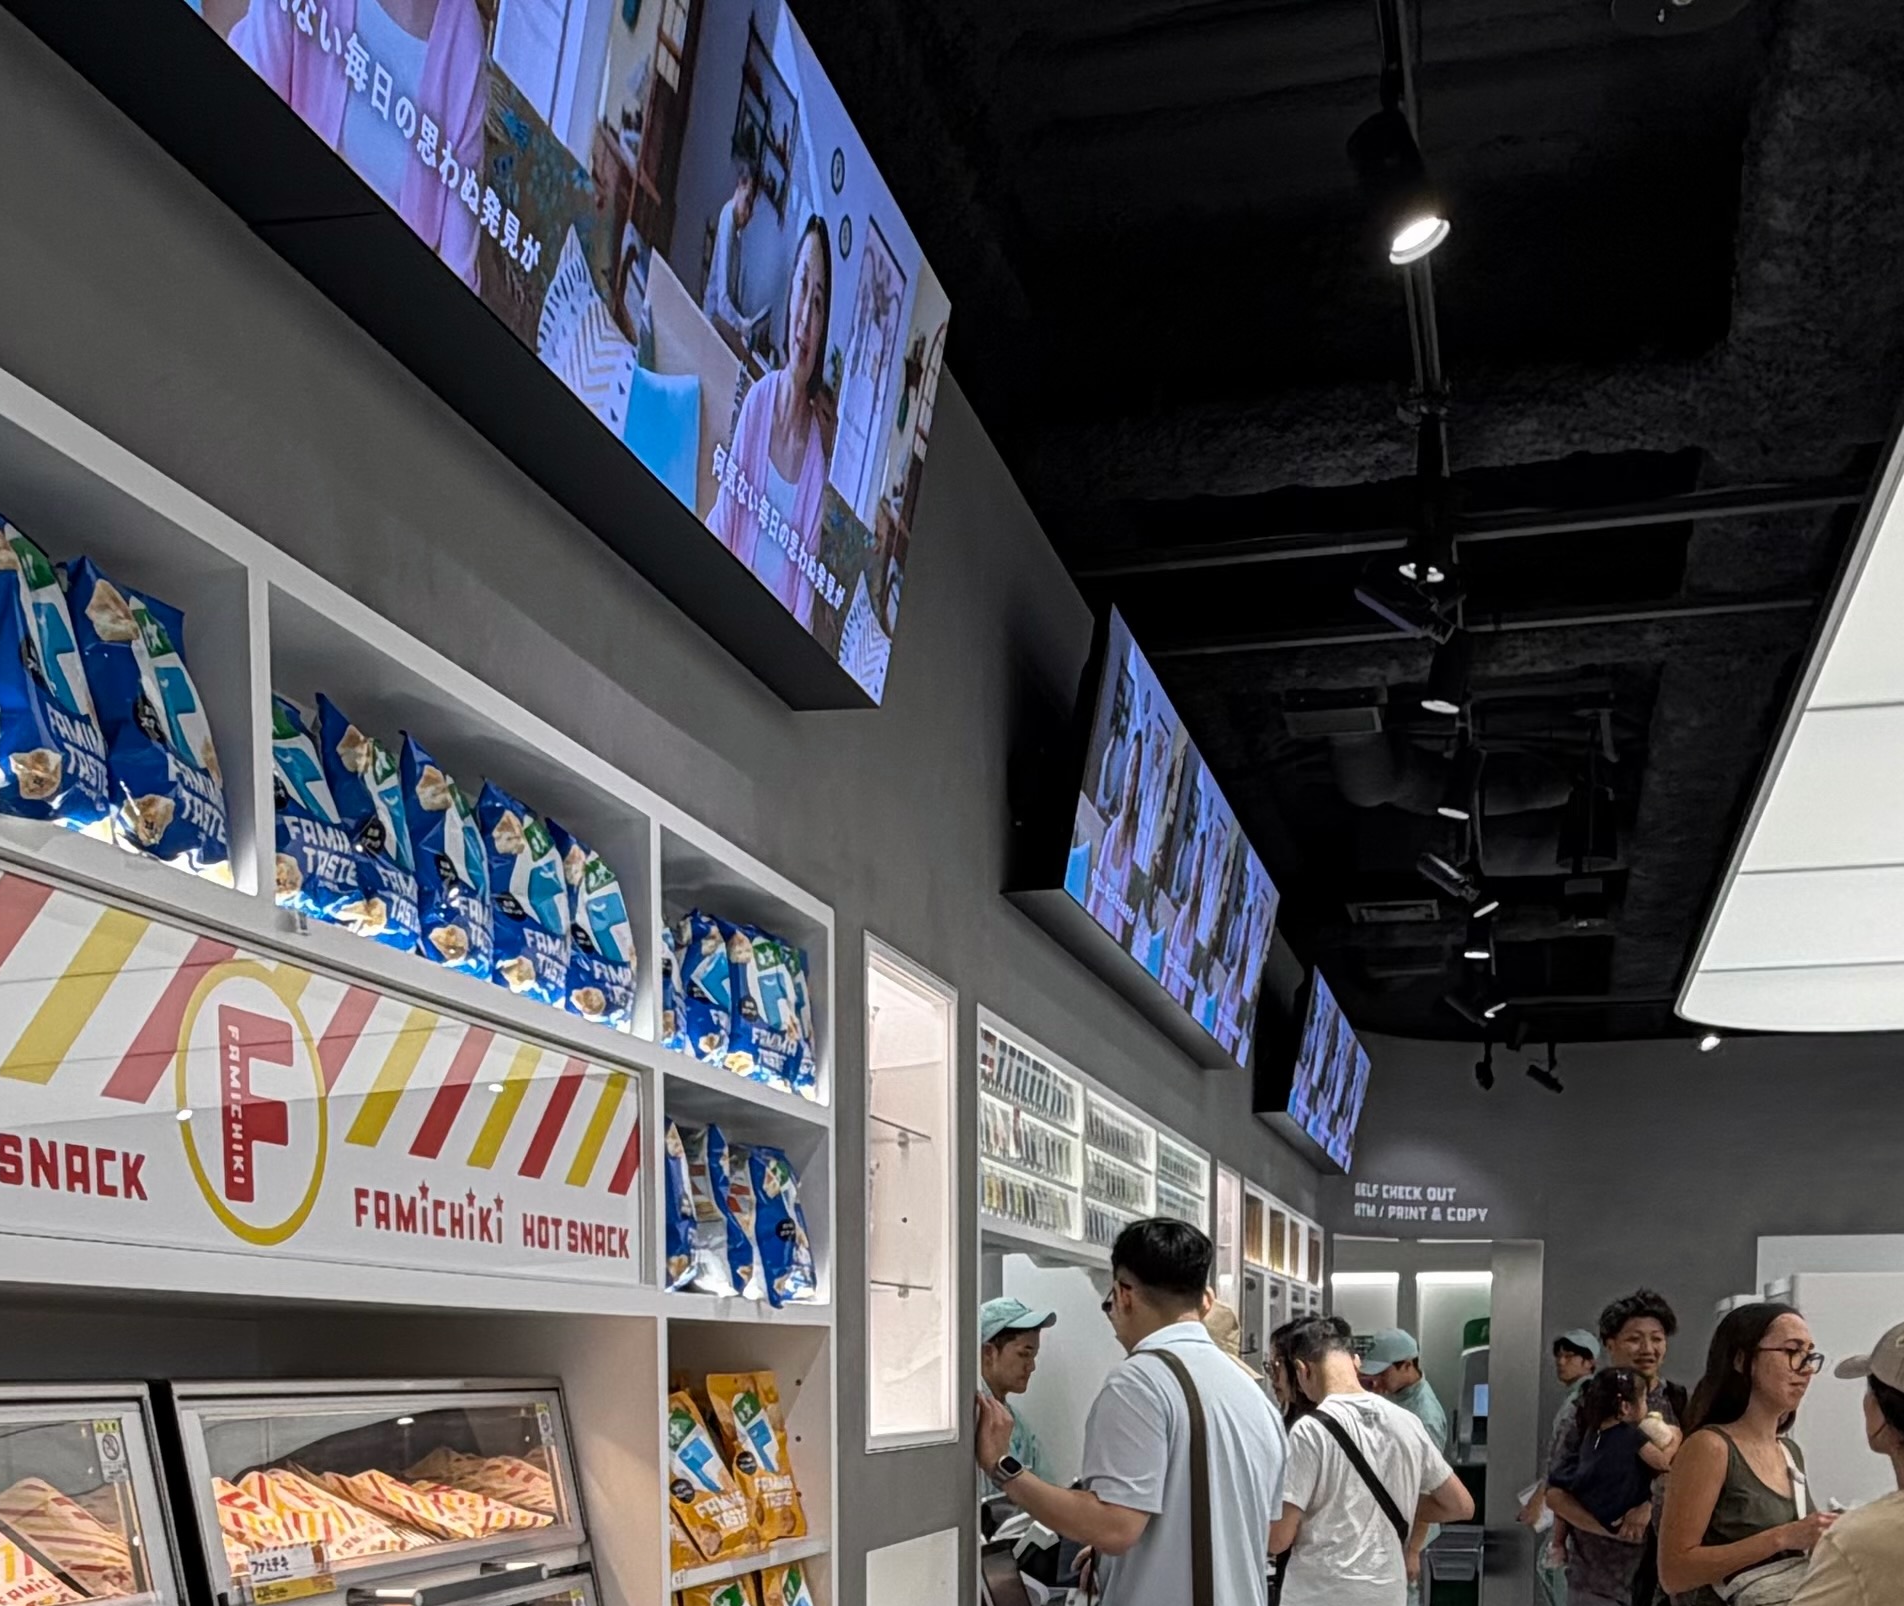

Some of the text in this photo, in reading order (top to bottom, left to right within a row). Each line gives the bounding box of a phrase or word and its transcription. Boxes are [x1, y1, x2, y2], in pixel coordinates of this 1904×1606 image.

[302, 844, 357, 887] TASTE
[1354, 1181, 1457, 1202] SELF CHECK OUT
[1353, 1201, 1377, 1218] ATM
[1387, 1204, 1428, 1221] PRINT
[1446, 1207, 1489, 1223] COPY
[521, 1212, 564, 1254] HOT
[566, 1219, 631, 1261] SNACK
